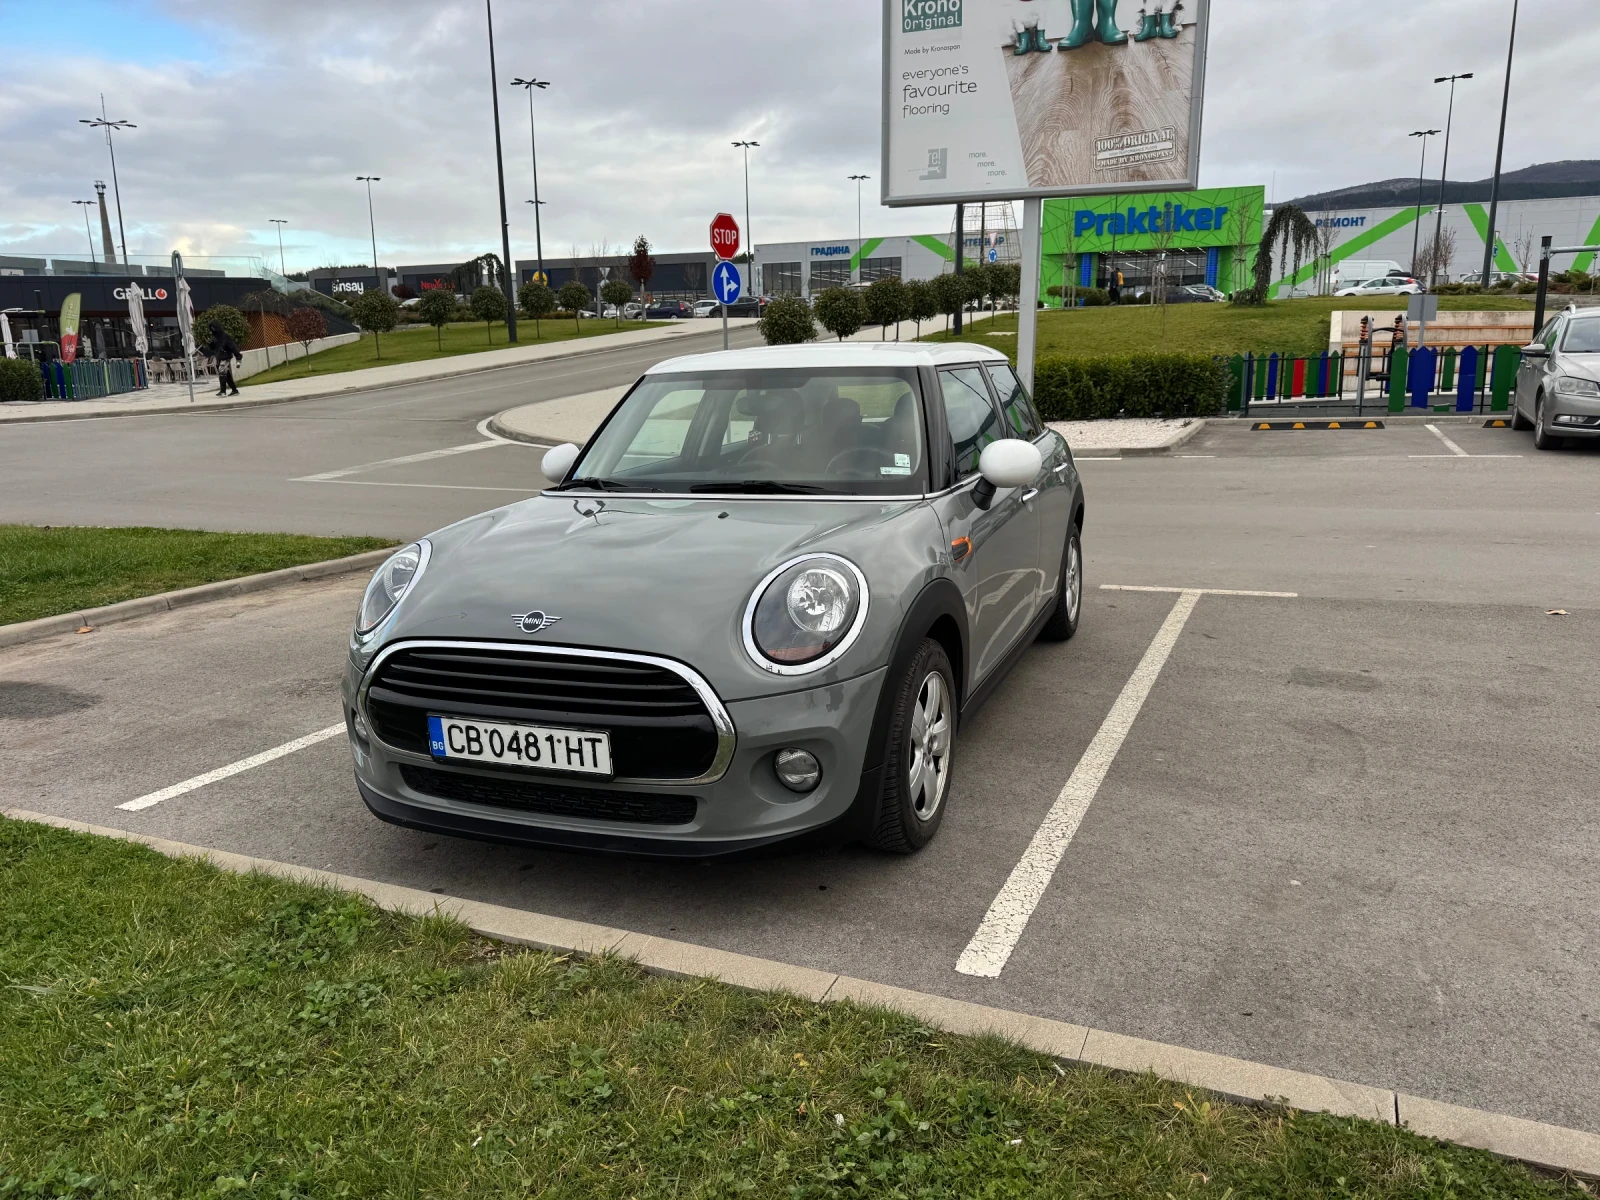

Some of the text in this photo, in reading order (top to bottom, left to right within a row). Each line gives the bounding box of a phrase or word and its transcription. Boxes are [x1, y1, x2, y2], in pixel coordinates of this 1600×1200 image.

[903, 0, 960, 17] Krono
[904, 12, 960, 30] Original
[904, 44, 961, 55] Made by Kronospan
[902, 64, 969, 81] everyone's
[902, 80, 978, 103] favourite
[902, 103, 950, 119] flooring
[1096, 129, 1173, 152] 100% ORIGINAL
[1101, 151, 1169, 167] MADE BY KRONOSPAN
[987, 169, 1007, 177] more.
[1074, 200, 1228, 238] Praktiker
[1315, 216, 1367, 228] РЕМОНТ
[713, 228, 737, 245] STOP
[811, 245, 850, 256] ГРАДИНА
[524, 617, 543, 625] MINI
[432, 740, 444, 750] BG
